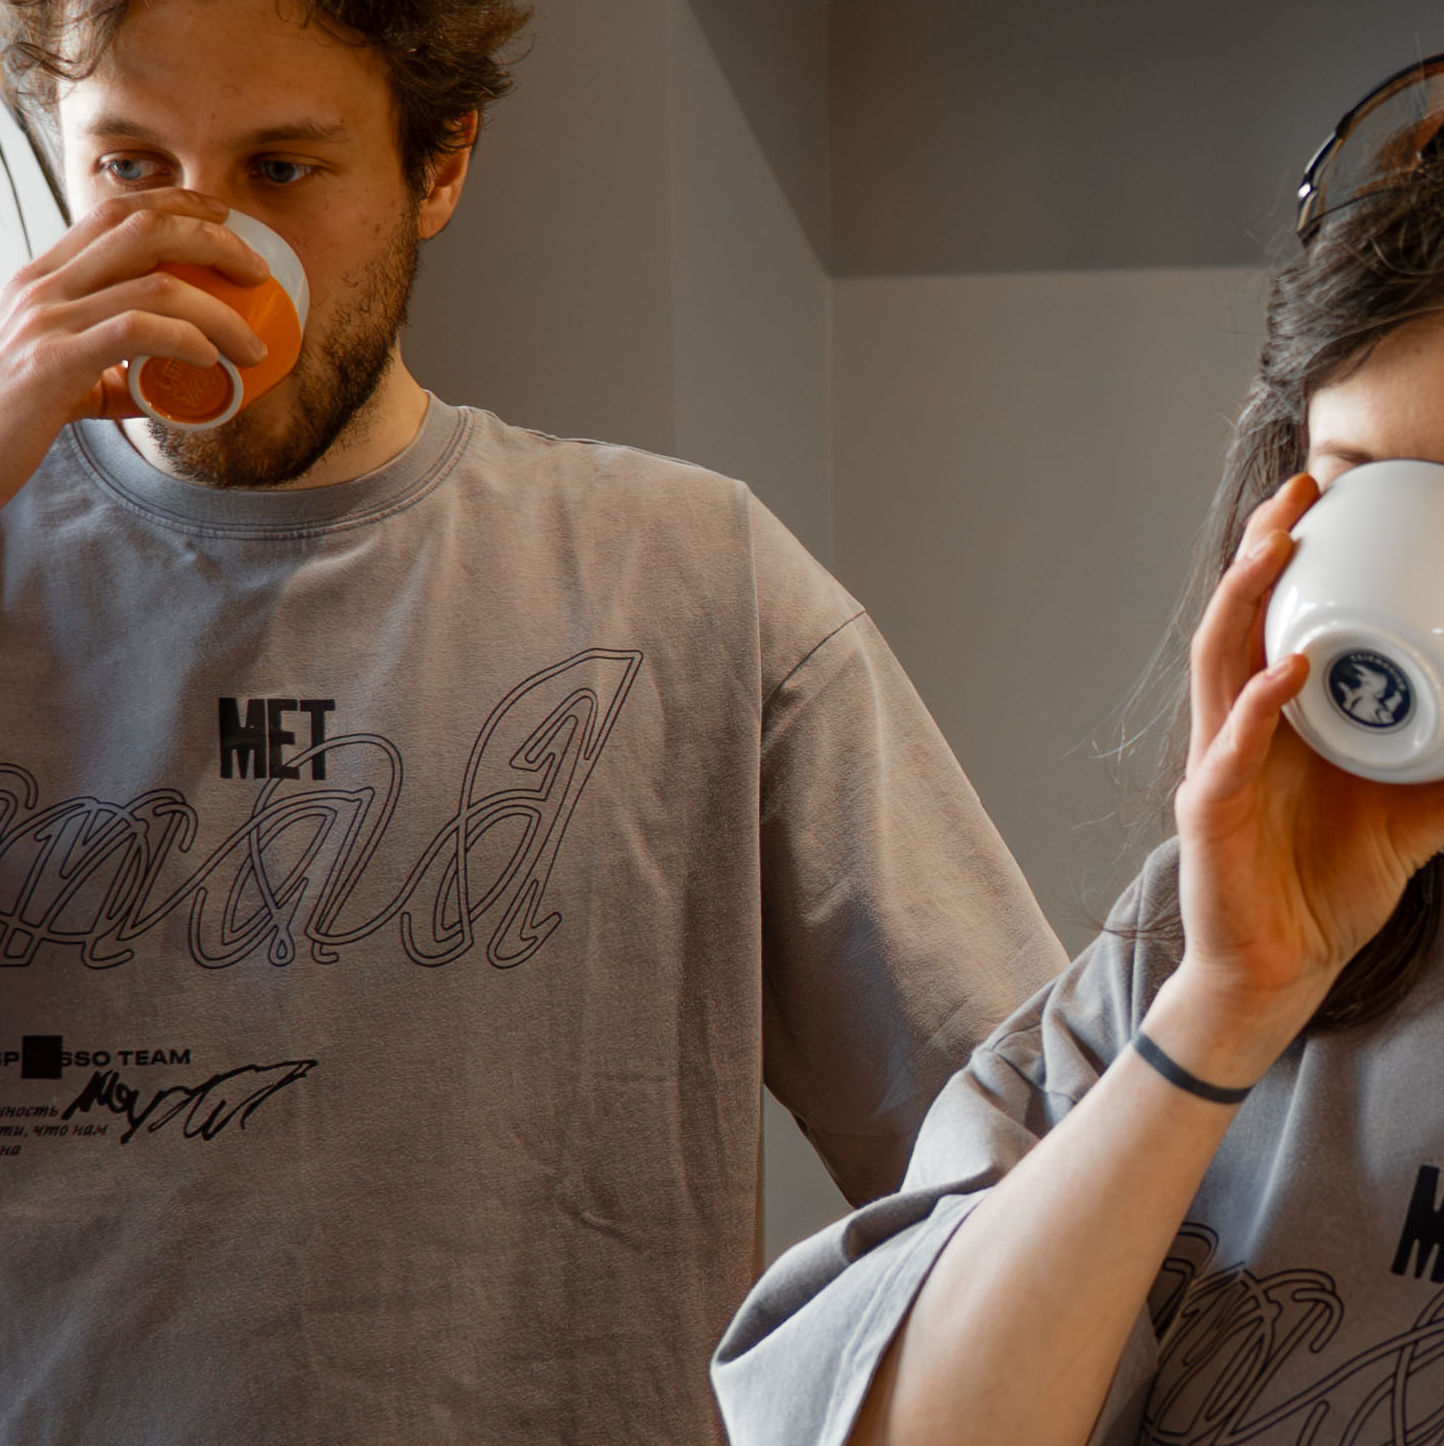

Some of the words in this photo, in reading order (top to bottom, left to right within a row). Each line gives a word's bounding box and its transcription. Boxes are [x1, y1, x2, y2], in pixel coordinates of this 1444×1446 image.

[218, 696, 336, 781] MET
[118, 1049, 191, 1067] TEAM
[33, 1125, 68, 1137] что
[72, 1124, 108, 1135] нам
